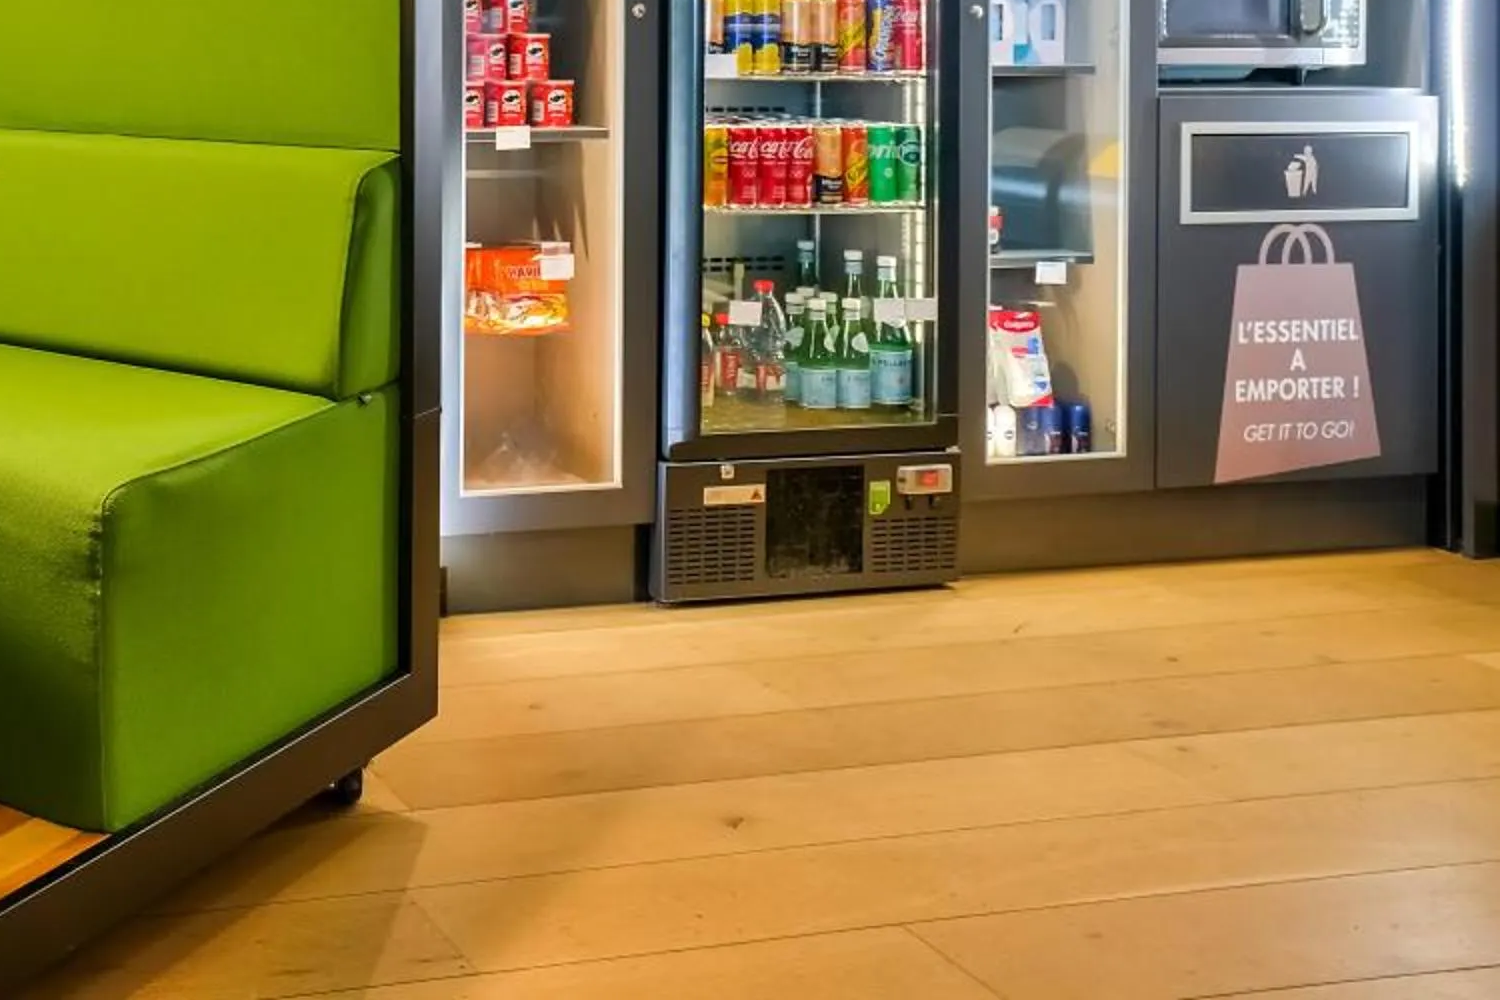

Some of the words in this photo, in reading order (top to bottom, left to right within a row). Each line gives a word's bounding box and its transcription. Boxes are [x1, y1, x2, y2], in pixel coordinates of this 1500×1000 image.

[1238, 318, 1359, 344] L'ESSENTIEL
[1289, 348, 1307, 372] A
[1235, 376, 1346, 402] EMPORTER
[1353, 375, 1359, 399] !
[1243, 423, 1276, 443] GET
[1279, 422, 1294, 441] IT
[1296, 421, 1318, 440] TO
[1321, 420, 1355, 439] GO!
